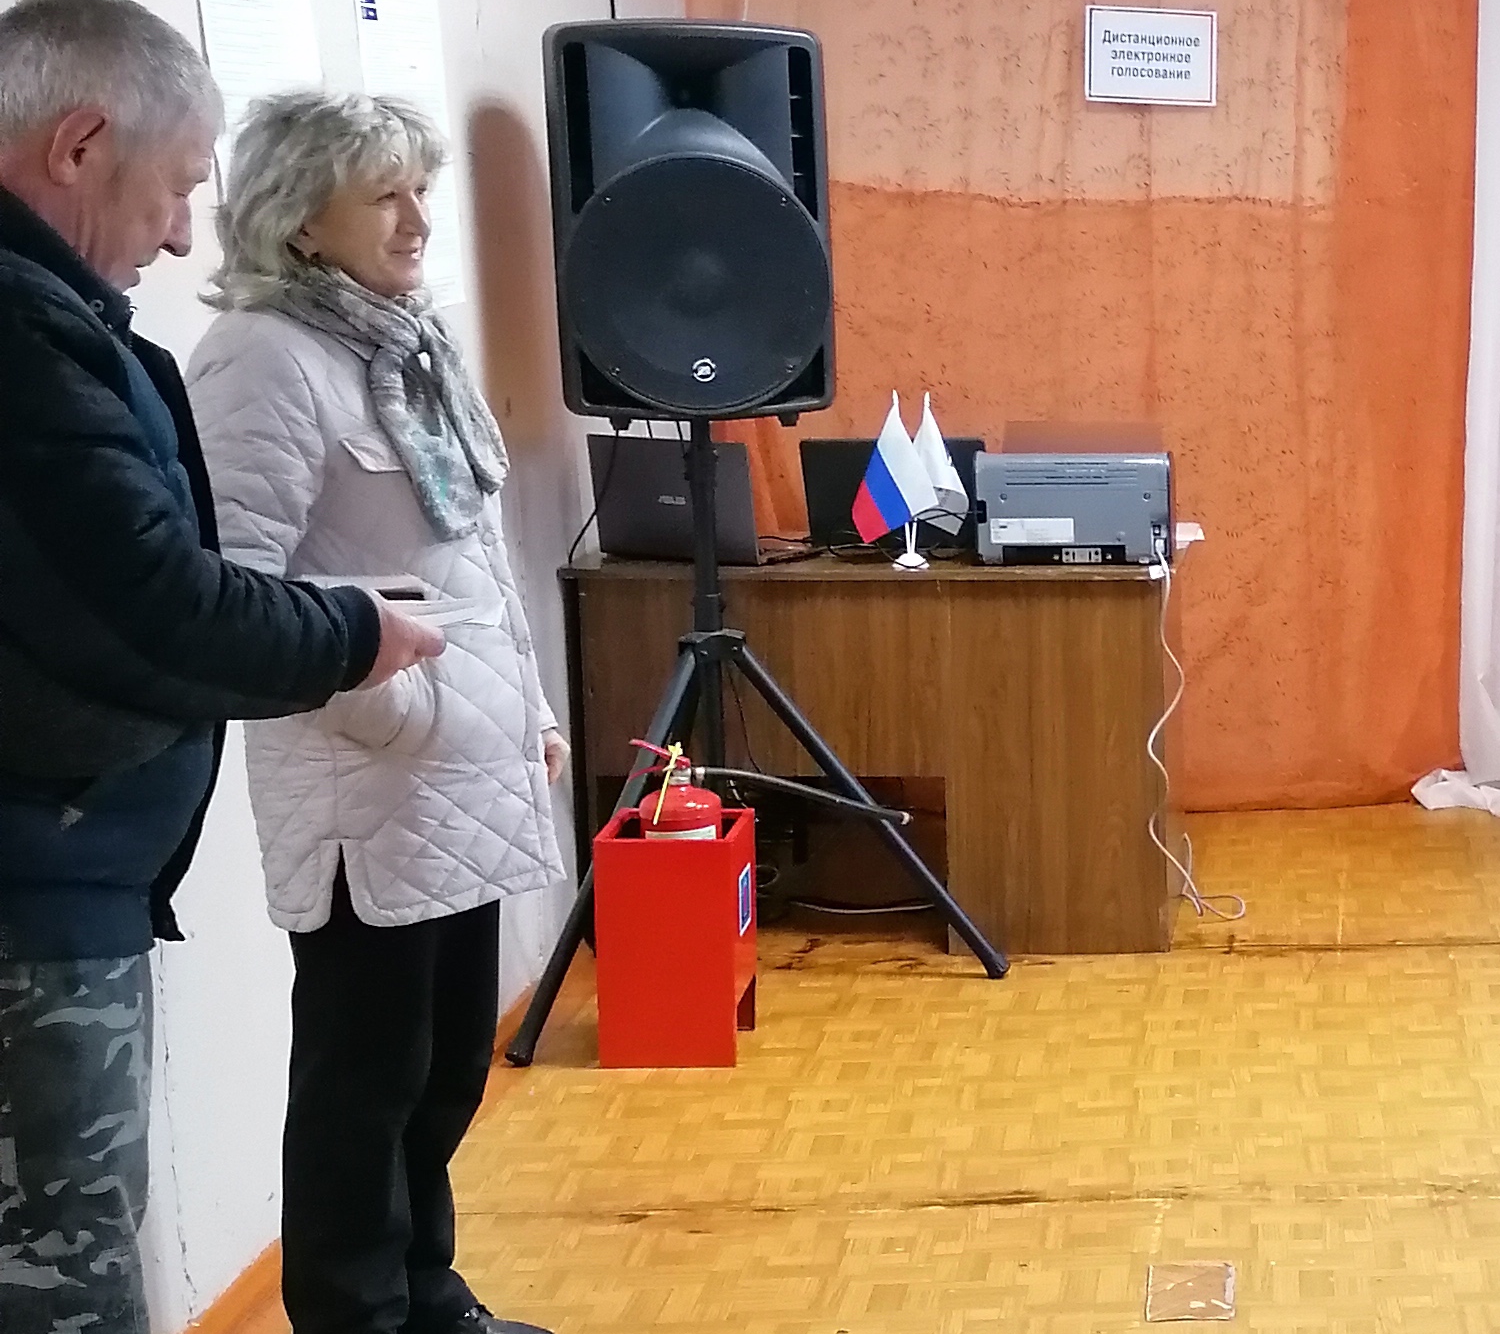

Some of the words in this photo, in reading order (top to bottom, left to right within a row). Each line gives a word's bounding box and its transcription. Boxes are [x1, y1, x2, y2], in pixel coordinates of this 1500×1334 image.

[1102, 29, 1201, 48] Дистанционное
[1110, 48, 1191, 64] электронное
[1110, 65, 1191, 80] голосование
